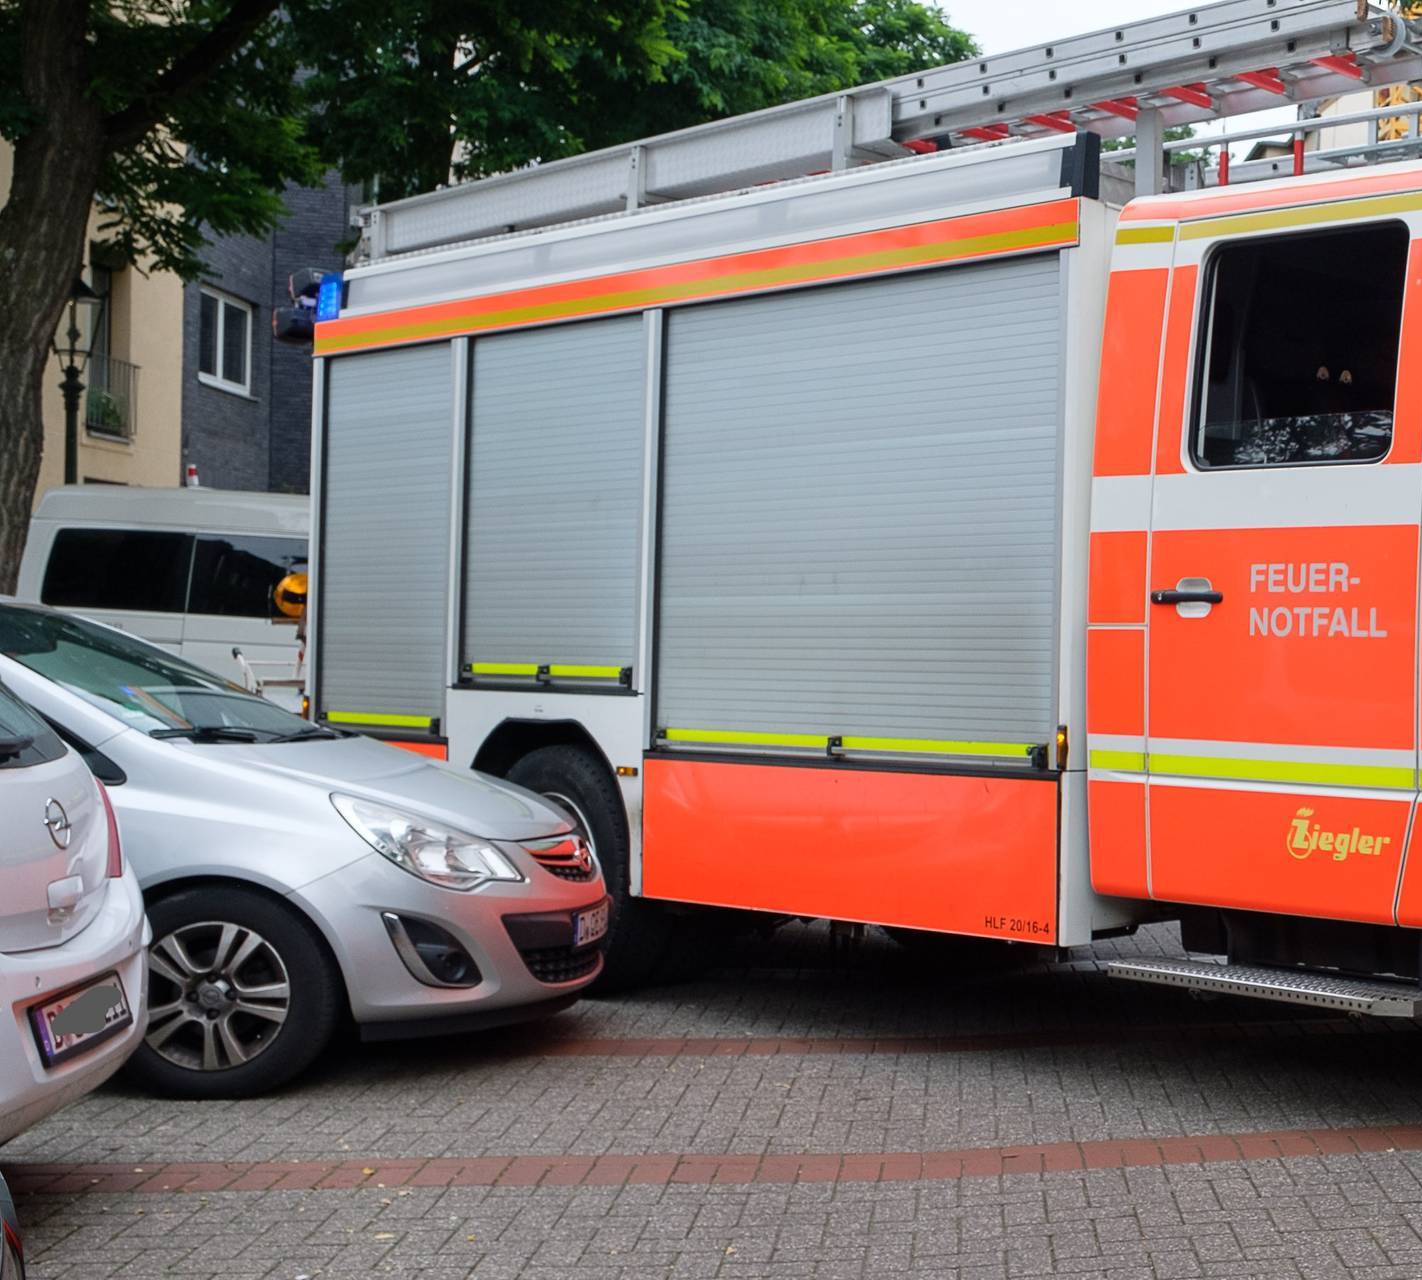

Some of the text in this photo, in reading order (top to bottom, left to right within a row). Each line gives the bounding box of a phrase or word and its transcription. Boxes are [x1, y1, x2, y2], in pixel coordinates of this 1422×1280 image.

[1250, 562, 1361, 593] FEUER-
[1249, 607, 1388, 637] NOTFALL
[1287, 808, 1391, 861] Ziegler
[984, 915, 1049, 935] HLF 20/16-4
